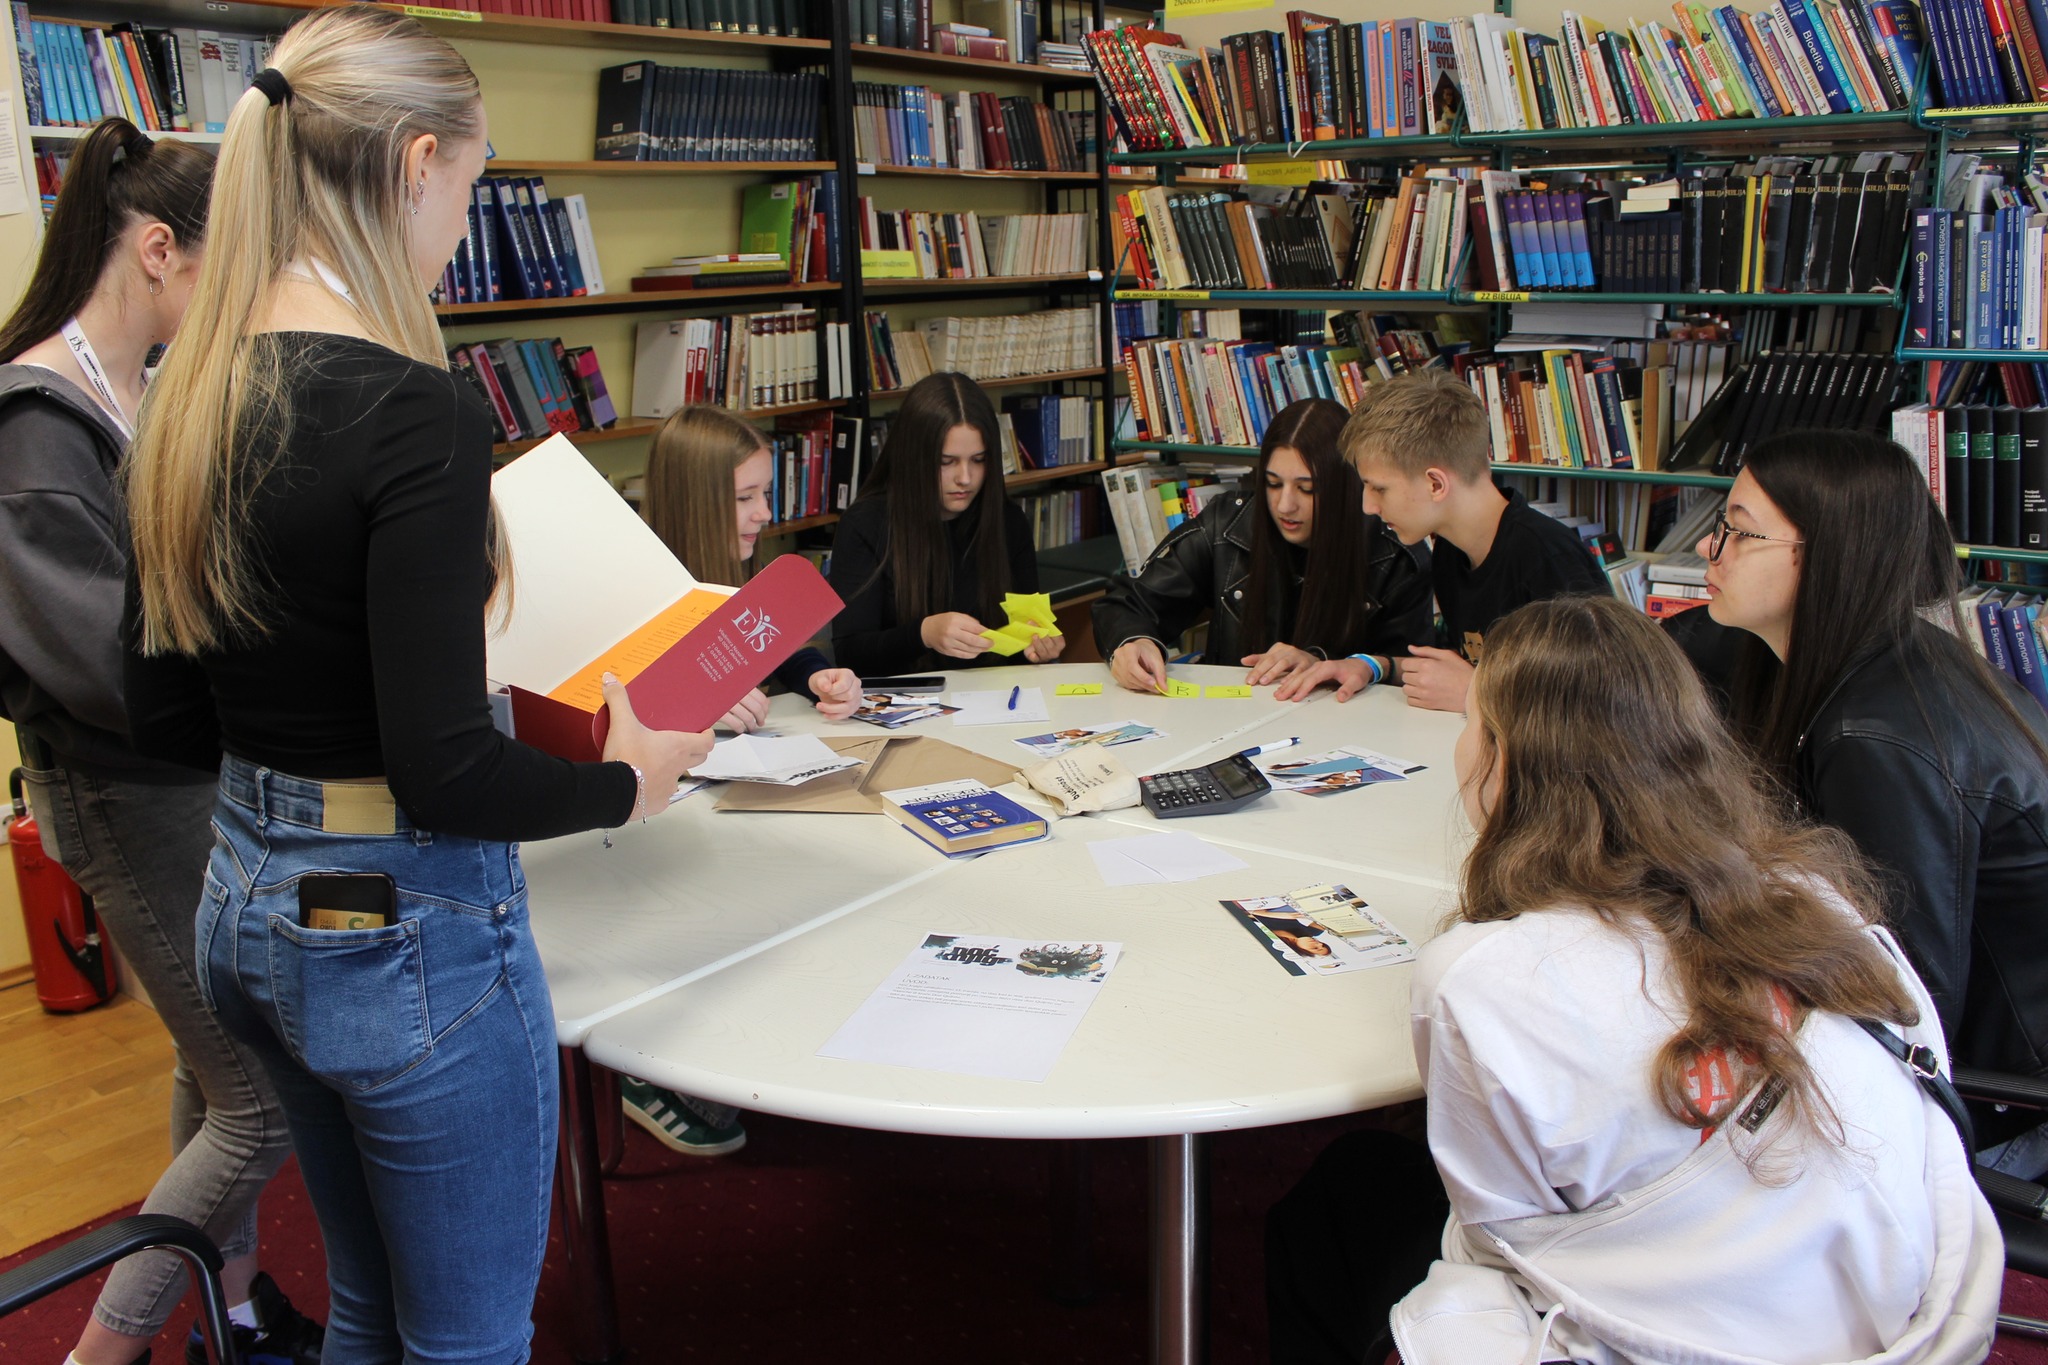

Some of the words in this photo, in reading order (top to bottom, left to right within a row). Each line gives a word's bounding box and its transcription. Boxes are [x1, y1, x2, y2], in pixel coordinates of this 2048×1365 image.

[1801, 29, 1827, 73] Bioetika
[2014, 4, 2035, 40] RUSIJA
[2027, 45, 2047, 81] ARAPI
[1253, 45, 1265, 89] KRISTALNO
[1259, 53, 1269, 79] SUNCE
[1402, 69, 1413, 83] 70
[1876, 42, 1895, 76] Poslovna
[1889, 75, 1903, 95] etika
[1159, 225, 1173, 253] Beskraj
[1938, 215, 1948, 254] INTEGRACIJA
[1936, 254, 1946, 286] EUROPSKIH
[1978, 269, 1988, 292] EUROPA
[1480, 292, 1491, 301] 22
[1492, 292, 1522, 302] BIBLIJA
[1916, 286, 1924, 303] unija
[1935, 286, 1945, 312] POLITIKA
[1123, 351, 1135, 377] UČITI
[1127, 378, 1142, 420] NAUČITE
[1928, 416, 1936, 445] EKONOMIJE
[1929, 446, 1937, 468] POVIJEST
[1929, 468, 1937, 487] KRATKA
[717, 626, 735, 647] Vladimira
[1990, 627, 2006, 670] Ekonomija
[720, 639, 730, 651] 000
[727, 647, 743, 666] Čakovec
[2015, 631, 2033, 675] Ekonomija
[904, 787, 981, 805] LEKSIKON
